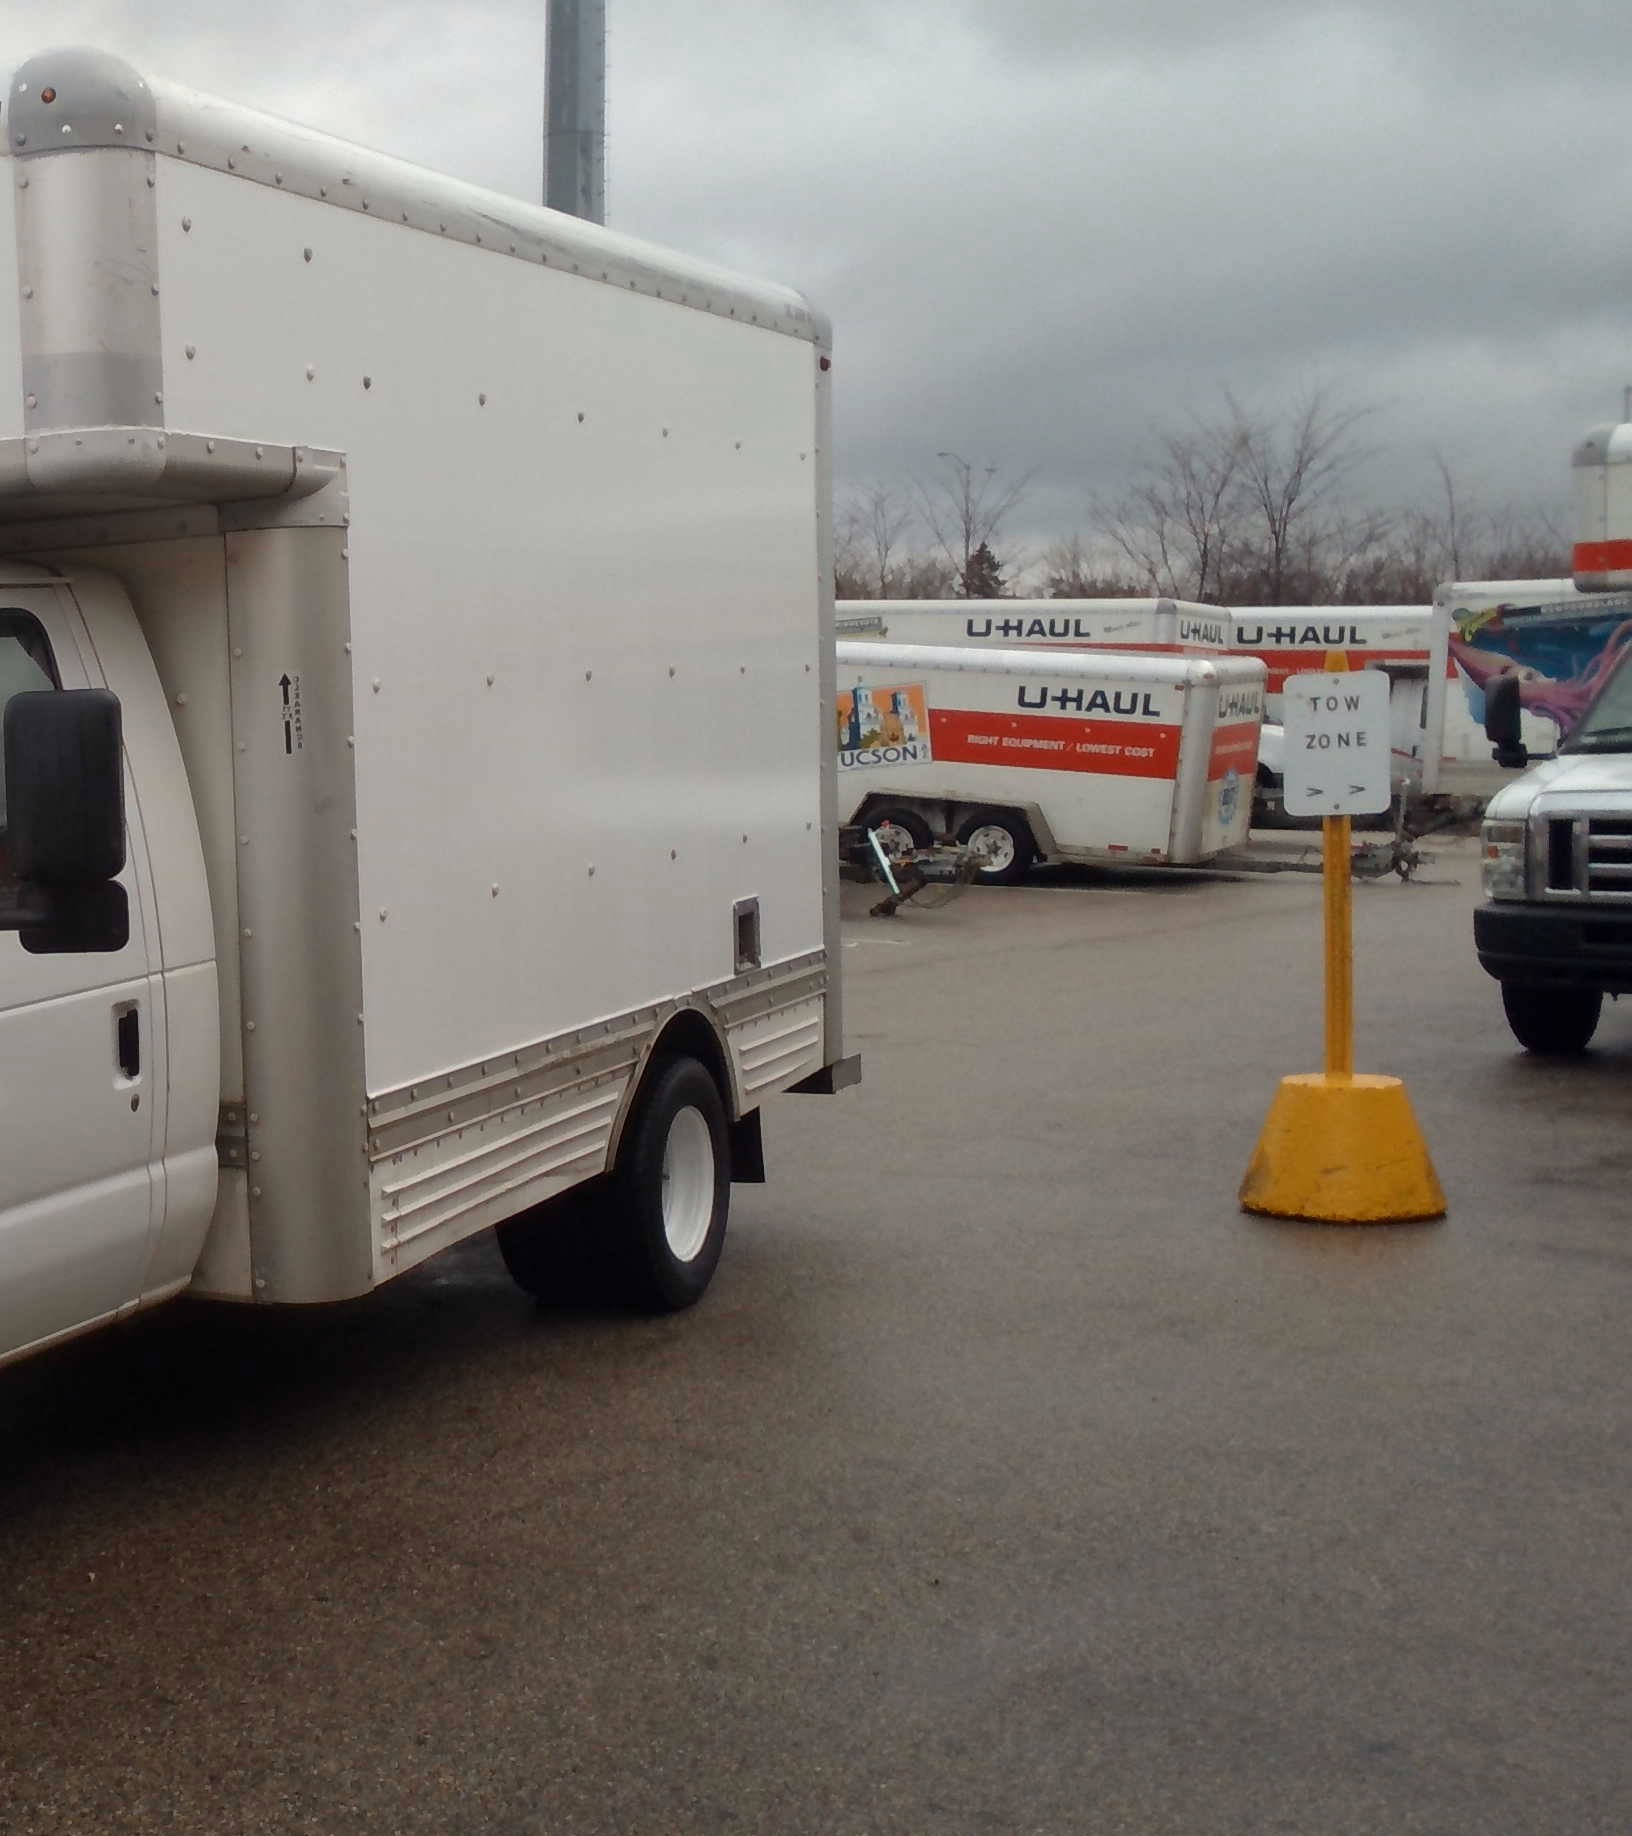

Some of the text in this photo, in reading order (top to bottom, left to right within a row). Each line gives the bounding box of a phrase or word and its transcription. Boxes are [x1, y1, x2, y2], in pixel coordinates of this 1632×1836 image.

[967, 618, 1090, 637] U-HAUL
[1236, 625, 1368, 645] U-HAUL
[1018, 685, 1161, 717] U-HAUL
[1310, 695, 1361, 713] TOW
[1305, 731, 1367, 750] ZONE
